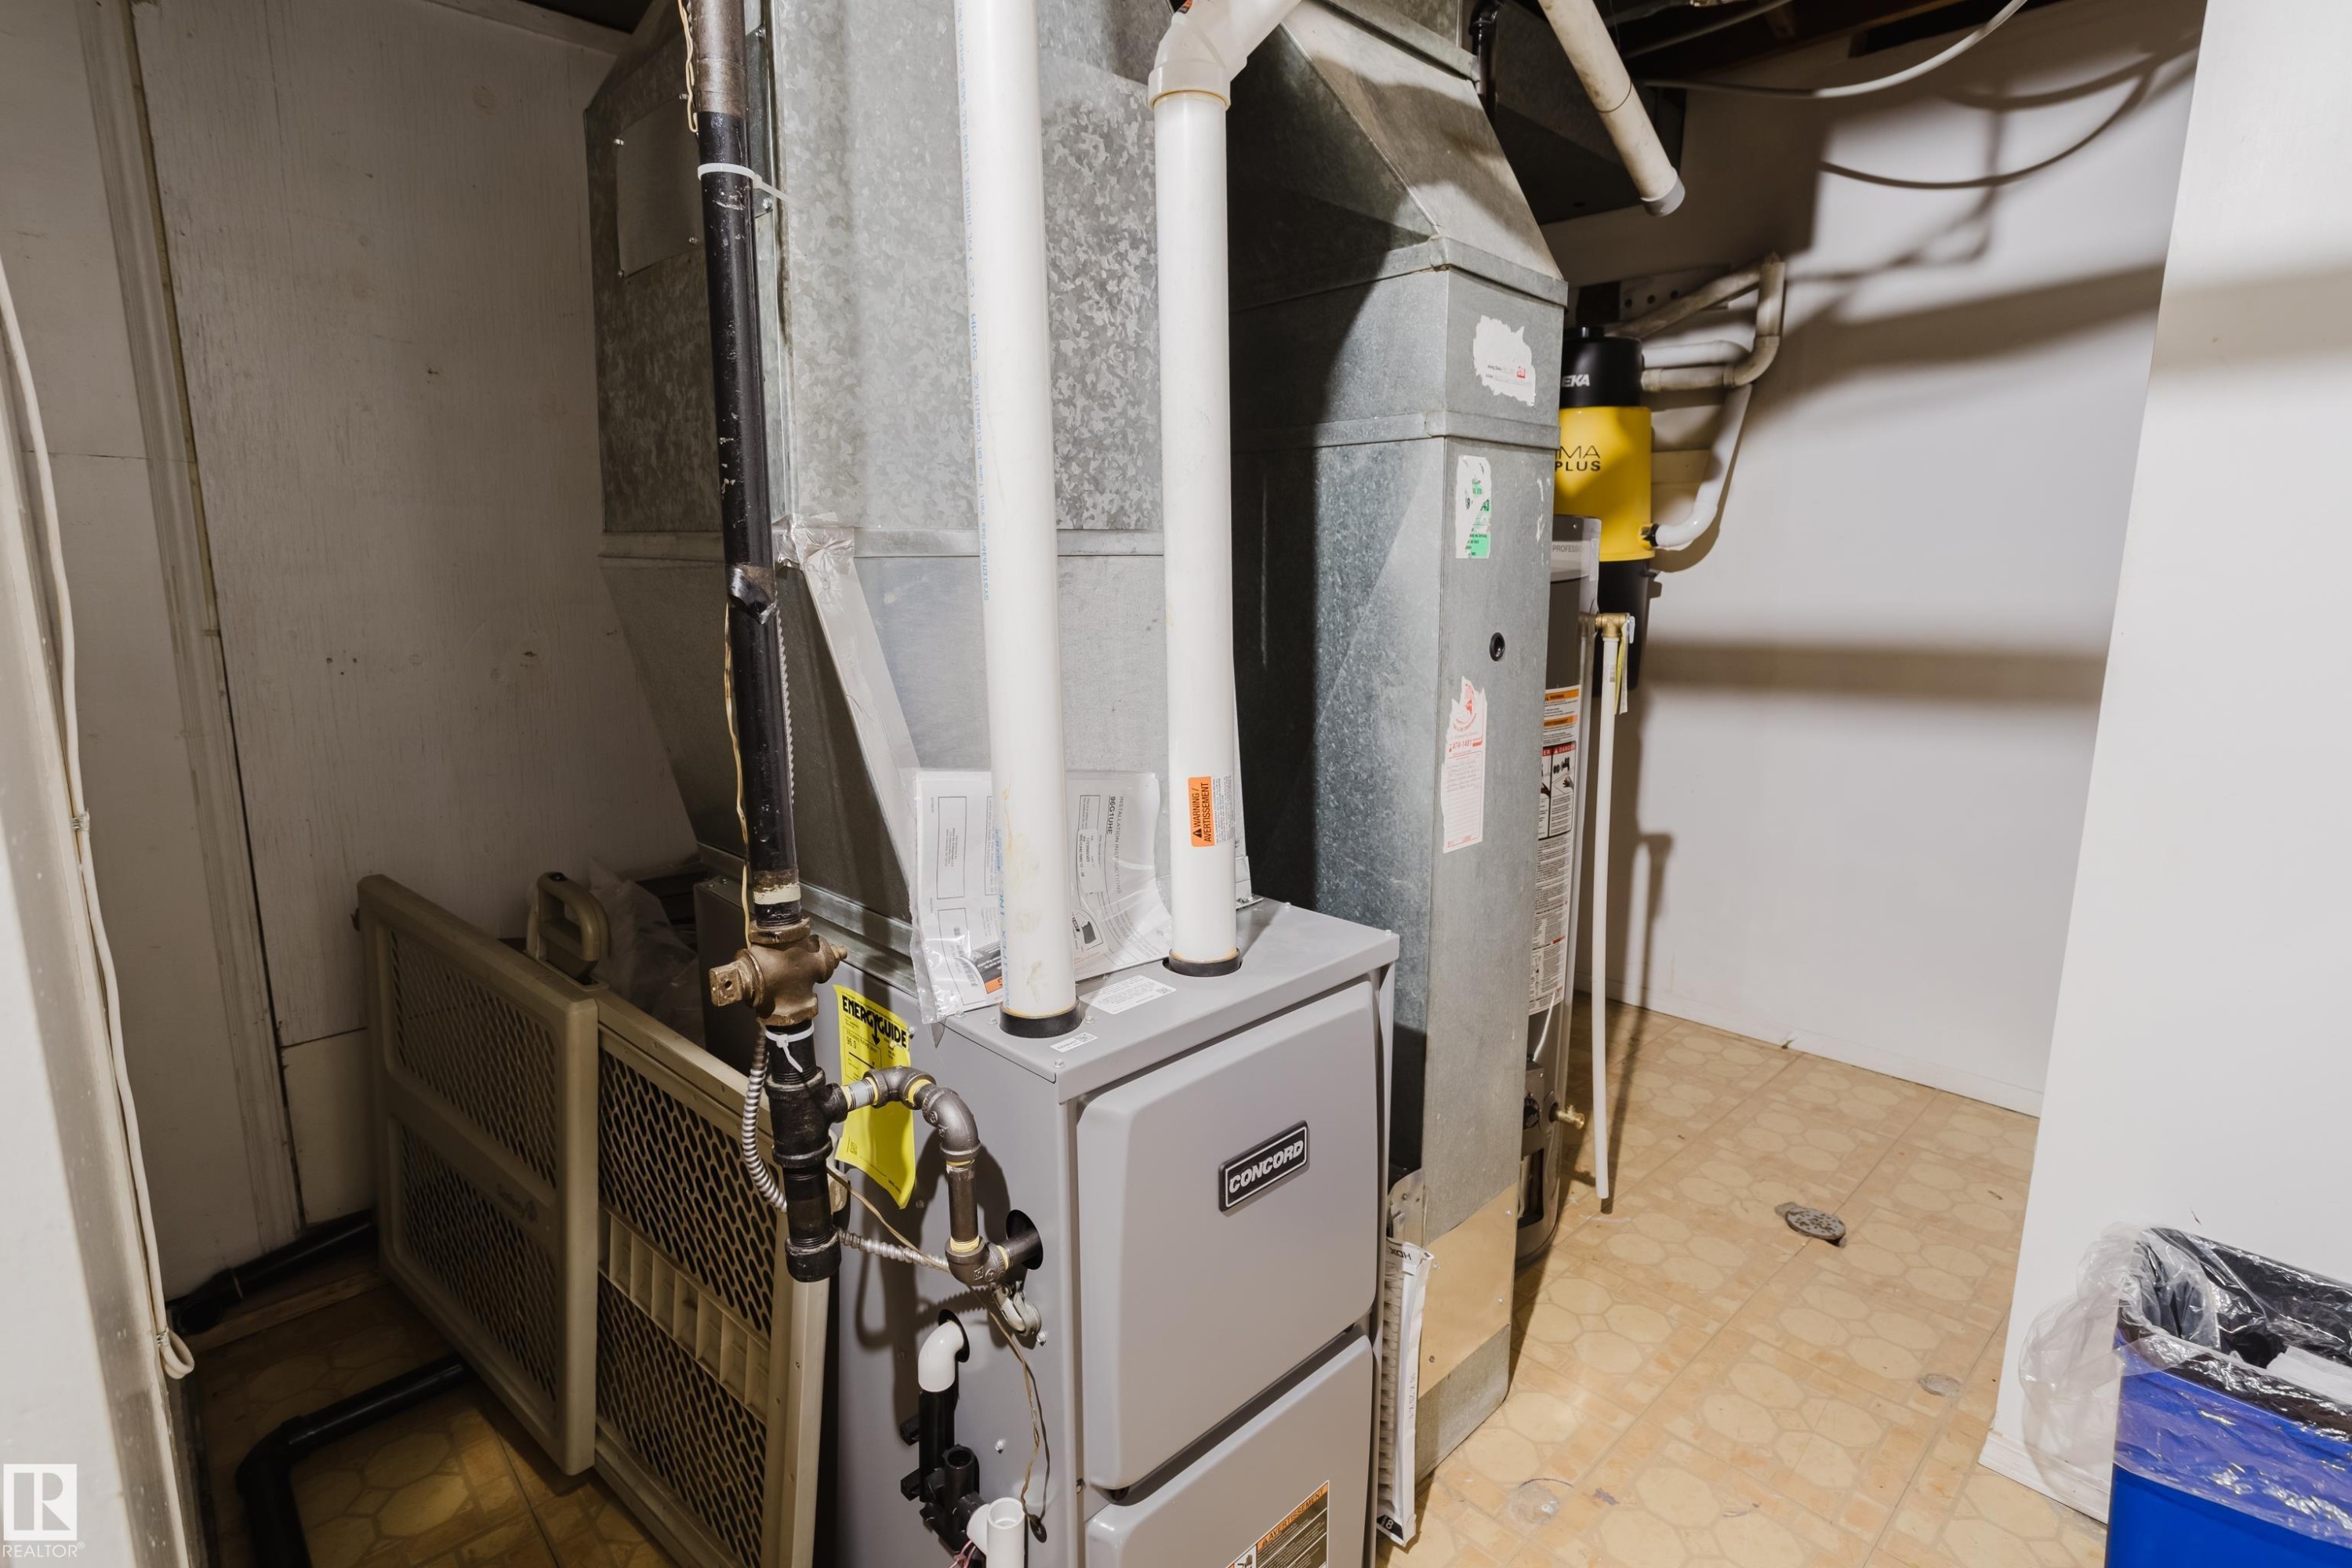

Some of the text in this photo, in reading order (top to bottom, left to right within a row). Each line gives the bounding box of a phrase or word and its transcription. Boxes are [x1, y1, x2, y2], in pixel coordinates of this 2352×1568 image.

[1555, 460, 1601, 472] PLUS
[1106, 796, 1116, 835] 96G1UHE
[1192, 793, 1201, 829] WARNING
[1201, 782, 1211, 843] AVERTISSEMENT
[1113, 796, 1124, 895] INSTALLATION INSTUCTIONS
[1229, 1140, 1304, 1193] CONCORD
[1268, 1488, 1324, 1541] AVERTISSEMENT
